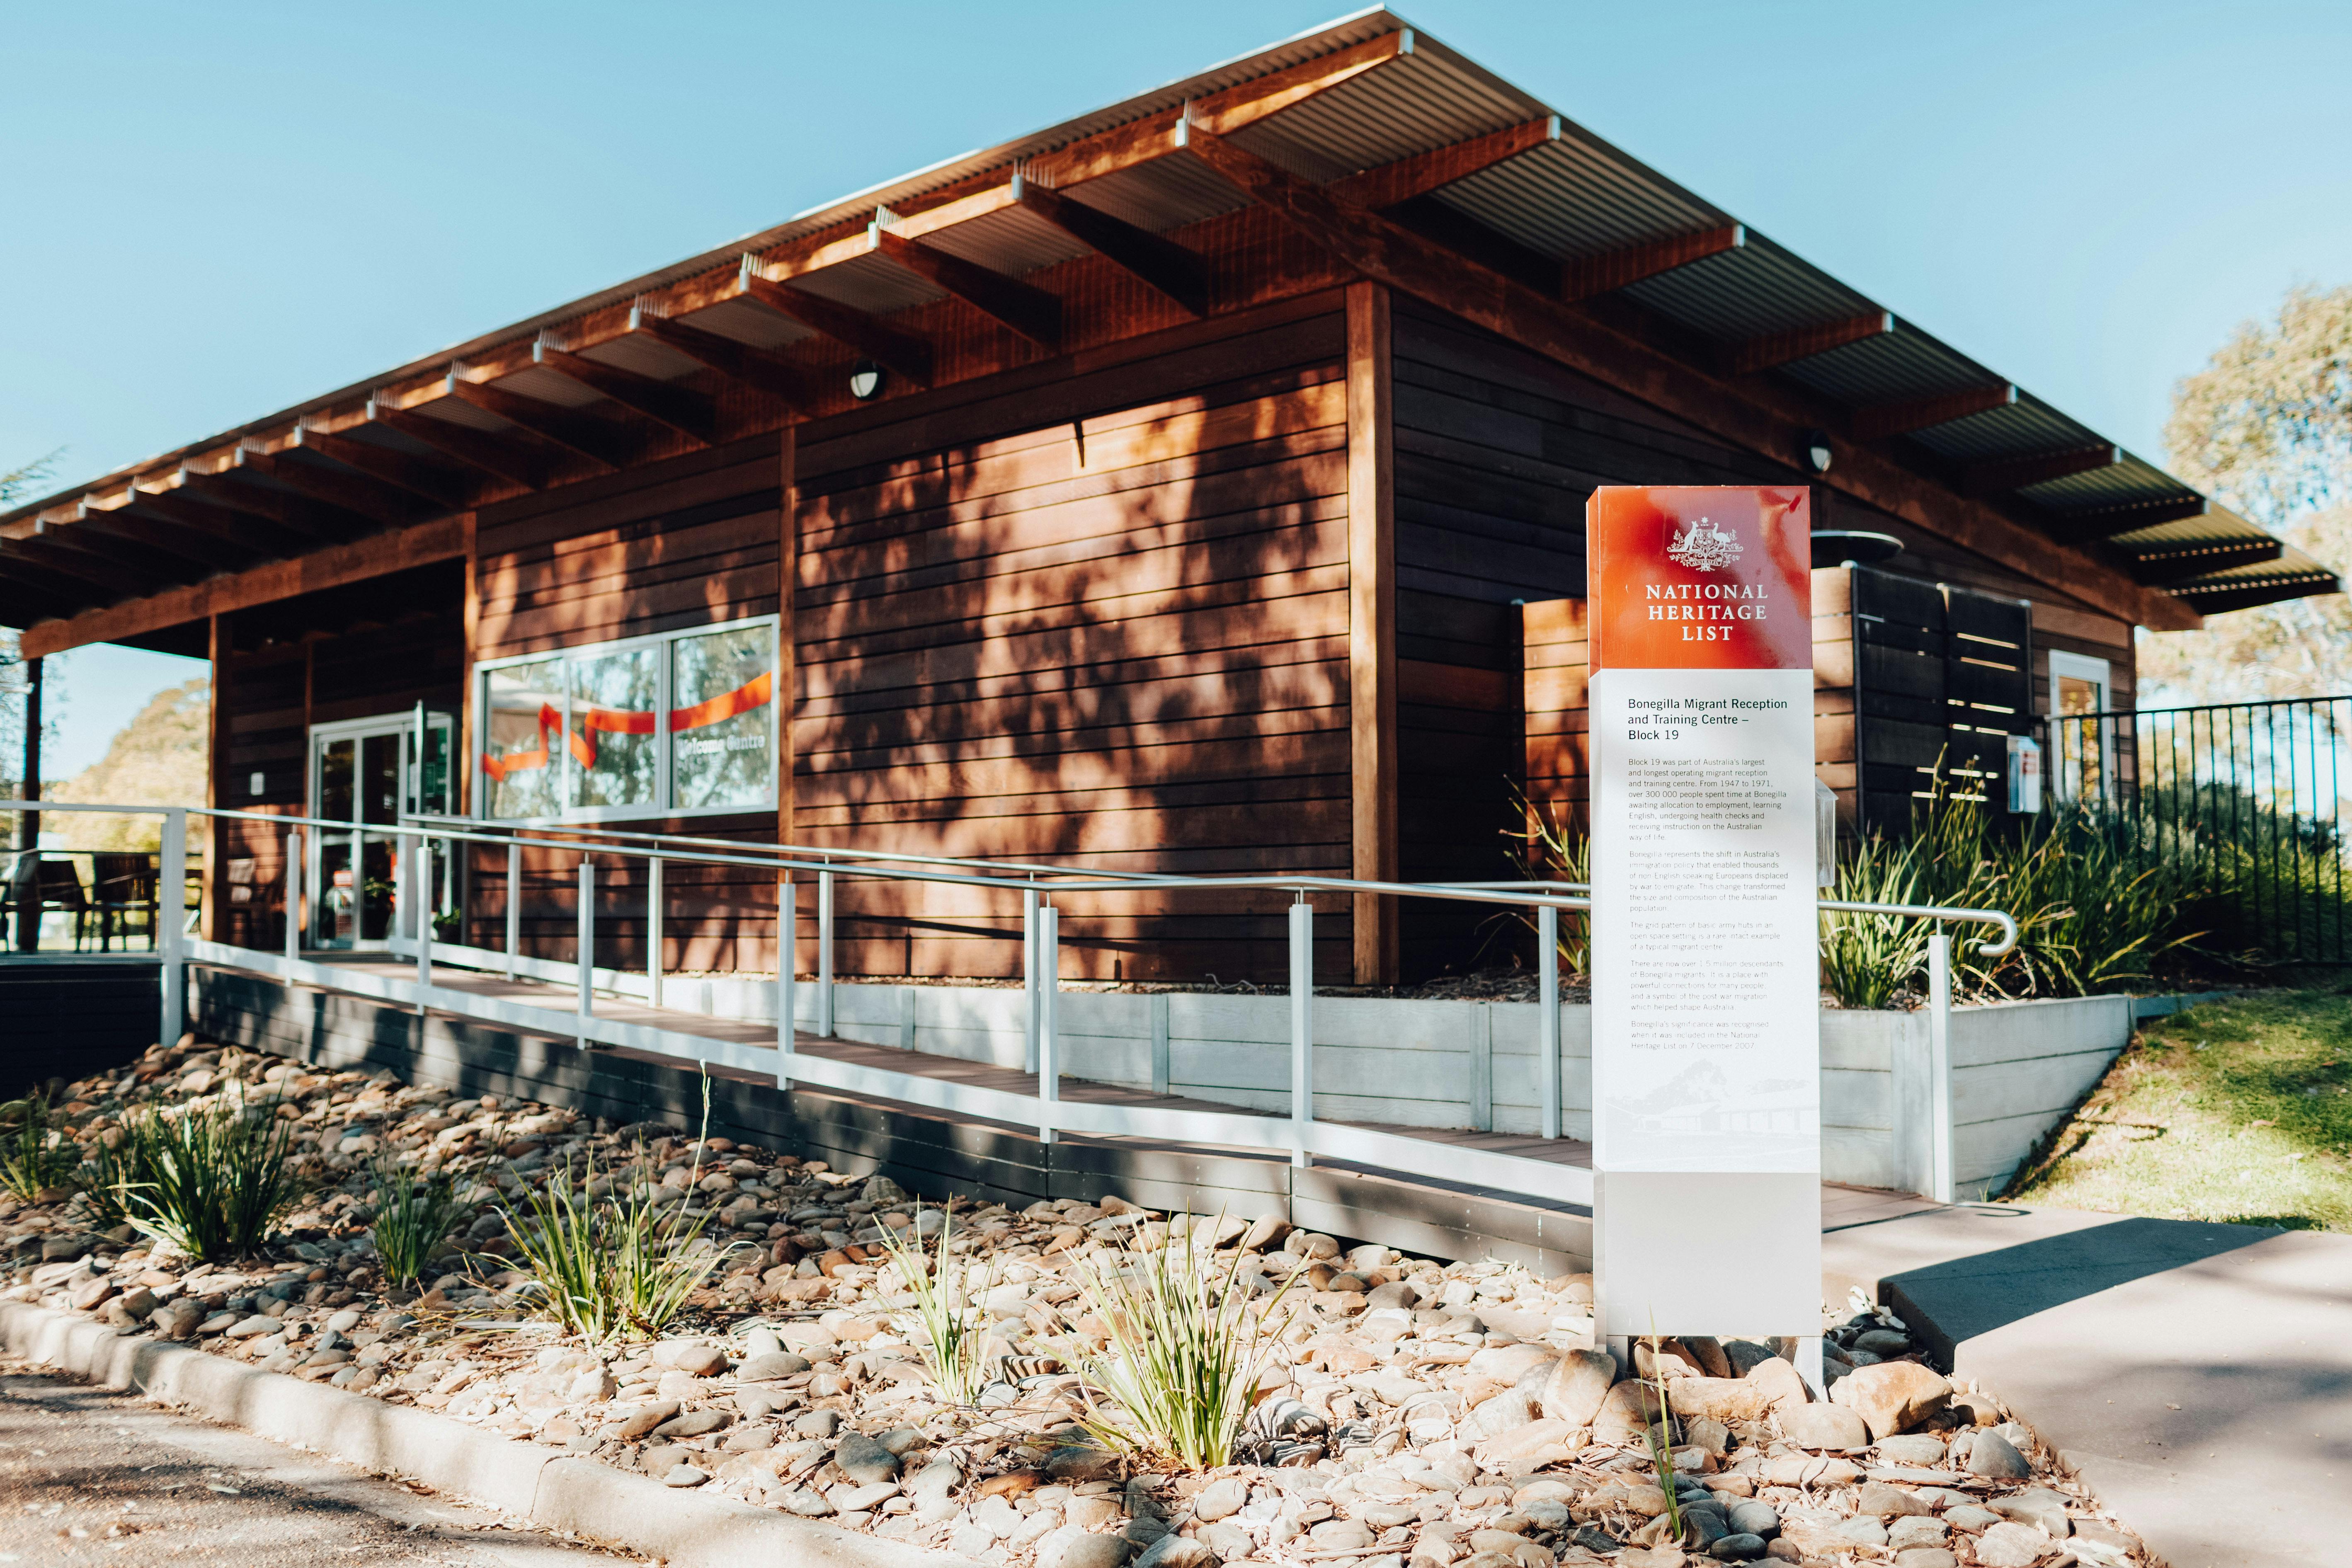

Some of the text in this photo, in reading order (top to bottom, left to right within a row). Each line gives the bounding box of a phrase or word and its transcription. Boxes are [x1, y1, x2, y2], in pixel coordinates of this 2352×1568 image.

[1646, 584, 1768, 599] NATIONAL
[1648, 606, 1767, 620] HERITAGE
[1682, 626, 1733, 641] LIST
[1628, 698, 1787, 711] Bonegilla Migrant Reception
[1628, 714, 1738, 727] and Training Centre
[1629, 729, 1679, 740] Block 19
[677, 734, 765, 754] Welcome Centre
[1741, 759, 1765, 767] largest
[1644, 769, 1669, 778] longest
[1671, 770, 1704, 778] operating
[1706, 769, 1733, 778] migrant
[1735, 769, 1768, 778] reception
[1644, 780, 1671, 789] training
[1680, 791, 1703, 799] people
[1705, 791, 1725, 799] spent
[1754, 790, 1787, 799] Bonegilla
[1628, 802, 1658, 810] awaiting
[1705, 801, 1751, 810] employment,
[1753, 801, 1782, 810] learning
[1629, 812, 1657, 821] English,
[1659, 812, 1699, 821] undergoing
[1629, 851, 1662, 859] Bonegilla
[1682, 872, 1714, 881] speaking
[1755, 872, 1788, 880] displaced
[1629, 883, 1638, 892] by
[1716, 883, 1742, 892] change
[1645, 921, 1659, 930] grid
[1646, 943, 1669, 952] typical
[1640, 971, 1673, 979] Bonegilla
[1631, 982, 1660, 990] powerful
[1734, 993, 1768, 1001] migration
[1654, 1003, 1678, 1012] helped
[1631, 1042, 1661, 1051] Heritage
